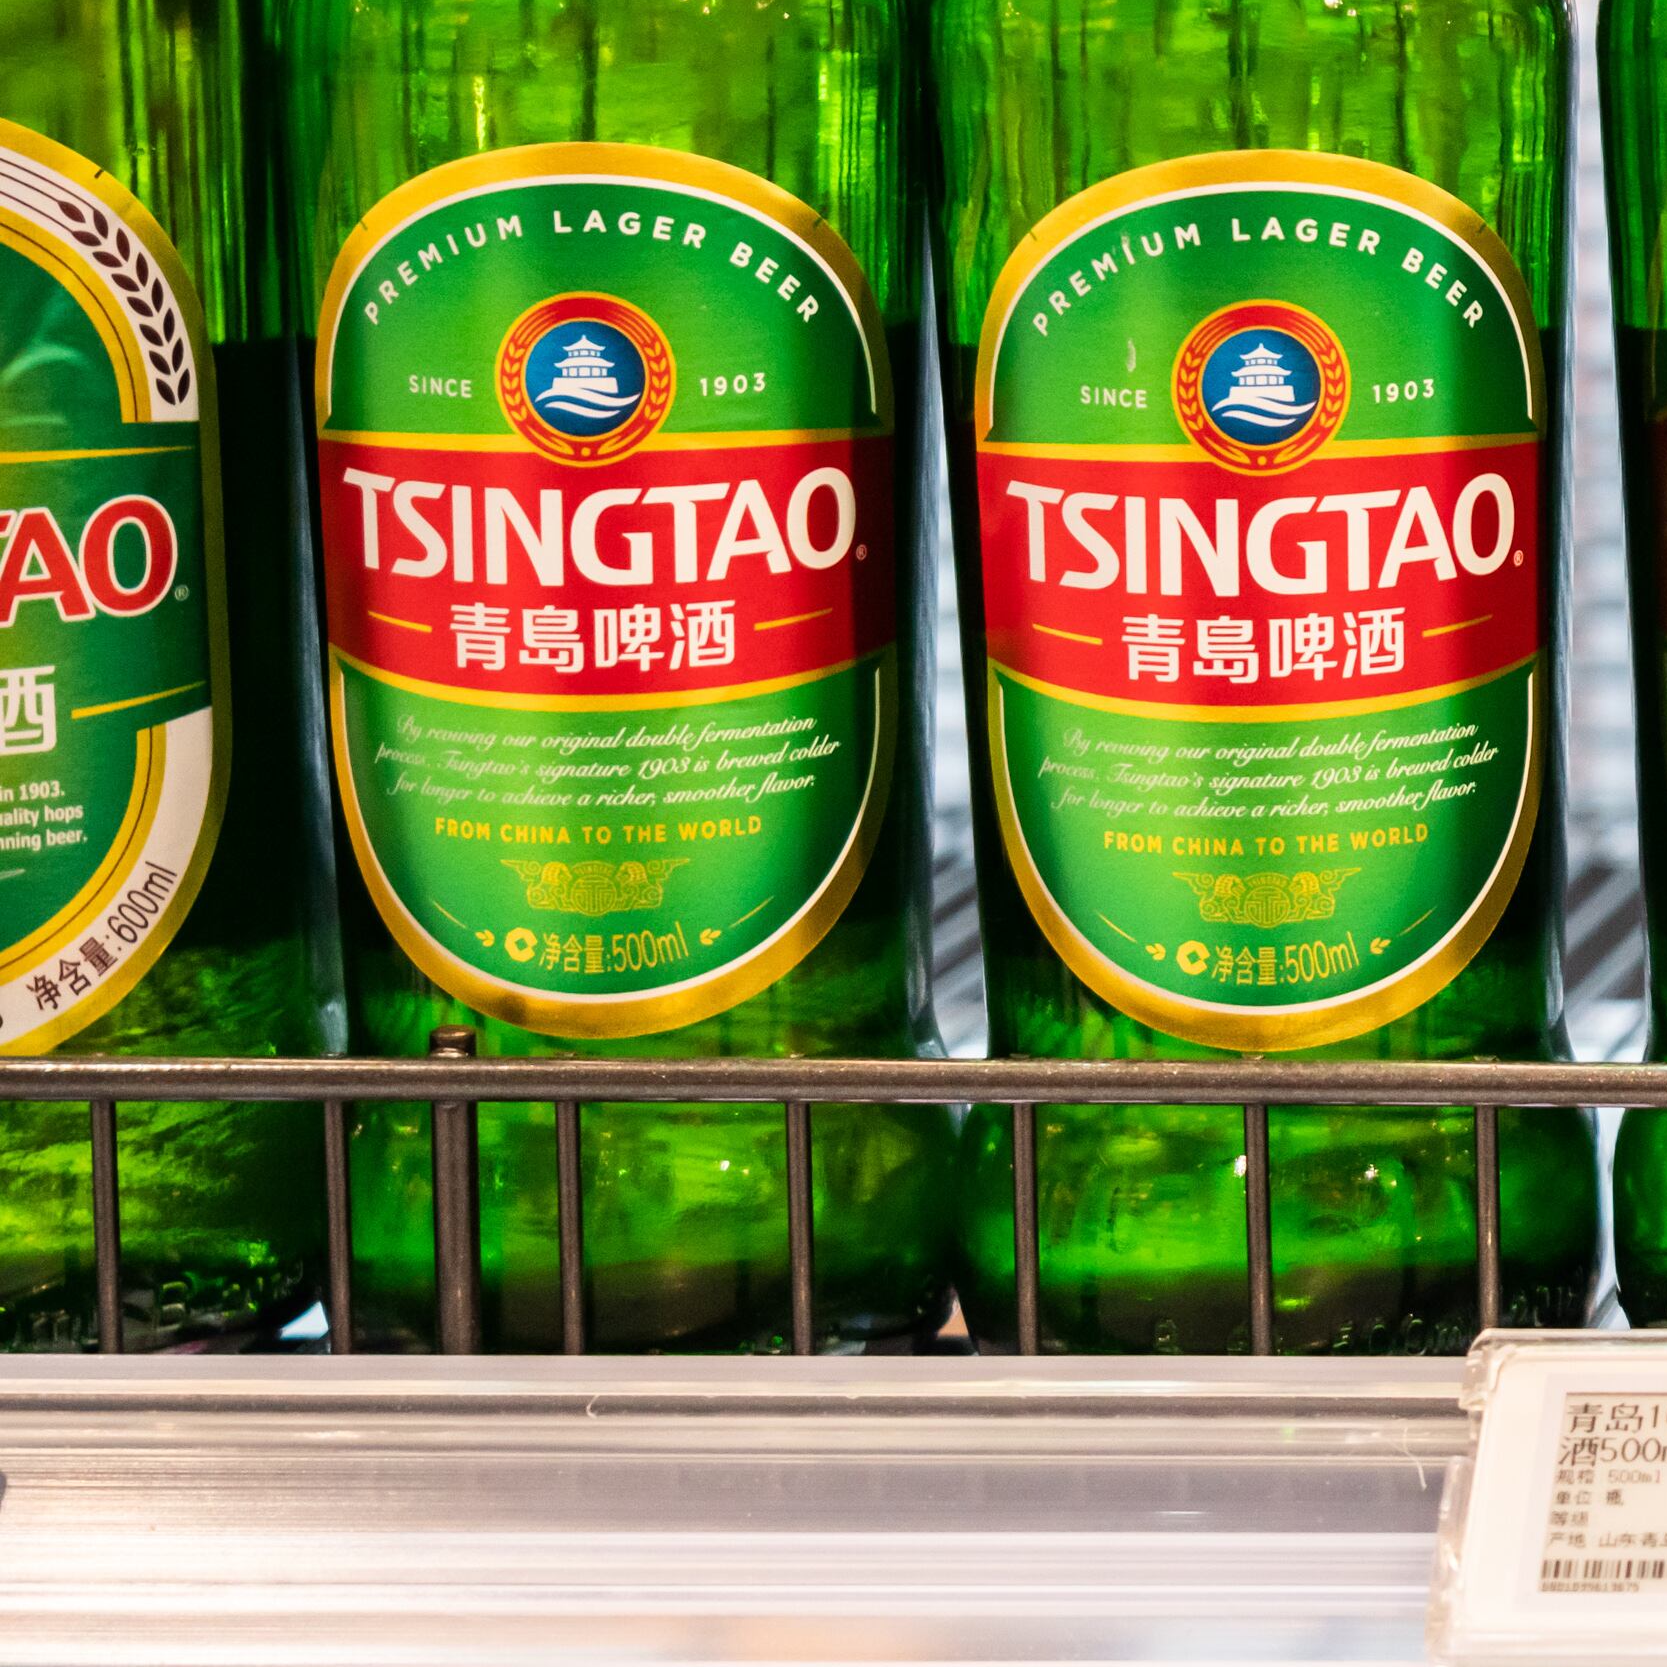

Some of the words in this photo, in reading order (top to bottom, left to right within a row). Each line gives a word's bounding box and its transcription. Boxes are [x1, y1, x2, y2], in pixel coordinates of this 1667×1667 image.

[365, 214, 523, 324] PREMIUM
[554, 210, 706, 248] LAGER
[731, 244, 820, 325] BEER
[1034, 225, 1201, 336] PREMIUM
[1232, 217, 1380, 255] LAGER
[1402, 249, 1485, 328] BEER
[409, 375, 472, 398] SINCE
[700, 373, 765, 396] 1903
[1081, 386, 1148, 409] SINCE
[1372, 379, 1434, 403] 1903
[344, 467, 855, 586] TSINGTAO
[1006, 473, 1514, 597] TSINGTAO
[0, 494, 178, 628] AO
[450, 600, 735, 673] 青島啤酒
[1121, 607, 1405, 684] 青島啤酒
[19, 780, 66, 801] 1903.
[44, 803, 84, 825] hops
[46, 828, 89, 847] beer.
[436, 817, 490, 840] FROM
[500, 823, 570, 844] CHINA
[582, 826, 611, 844] TO
[623, 823, 667, 842] THE
[678, 816, 761, 840] WORLD
[1104, 831, 1162, 854] FROM
[1171, 836, 1243, 856] CHINA
[1255, 837, 1285, 855] TO
[1296, 833, 1339, 853] THE
[1349, 824, 1427, 851] WORLD
